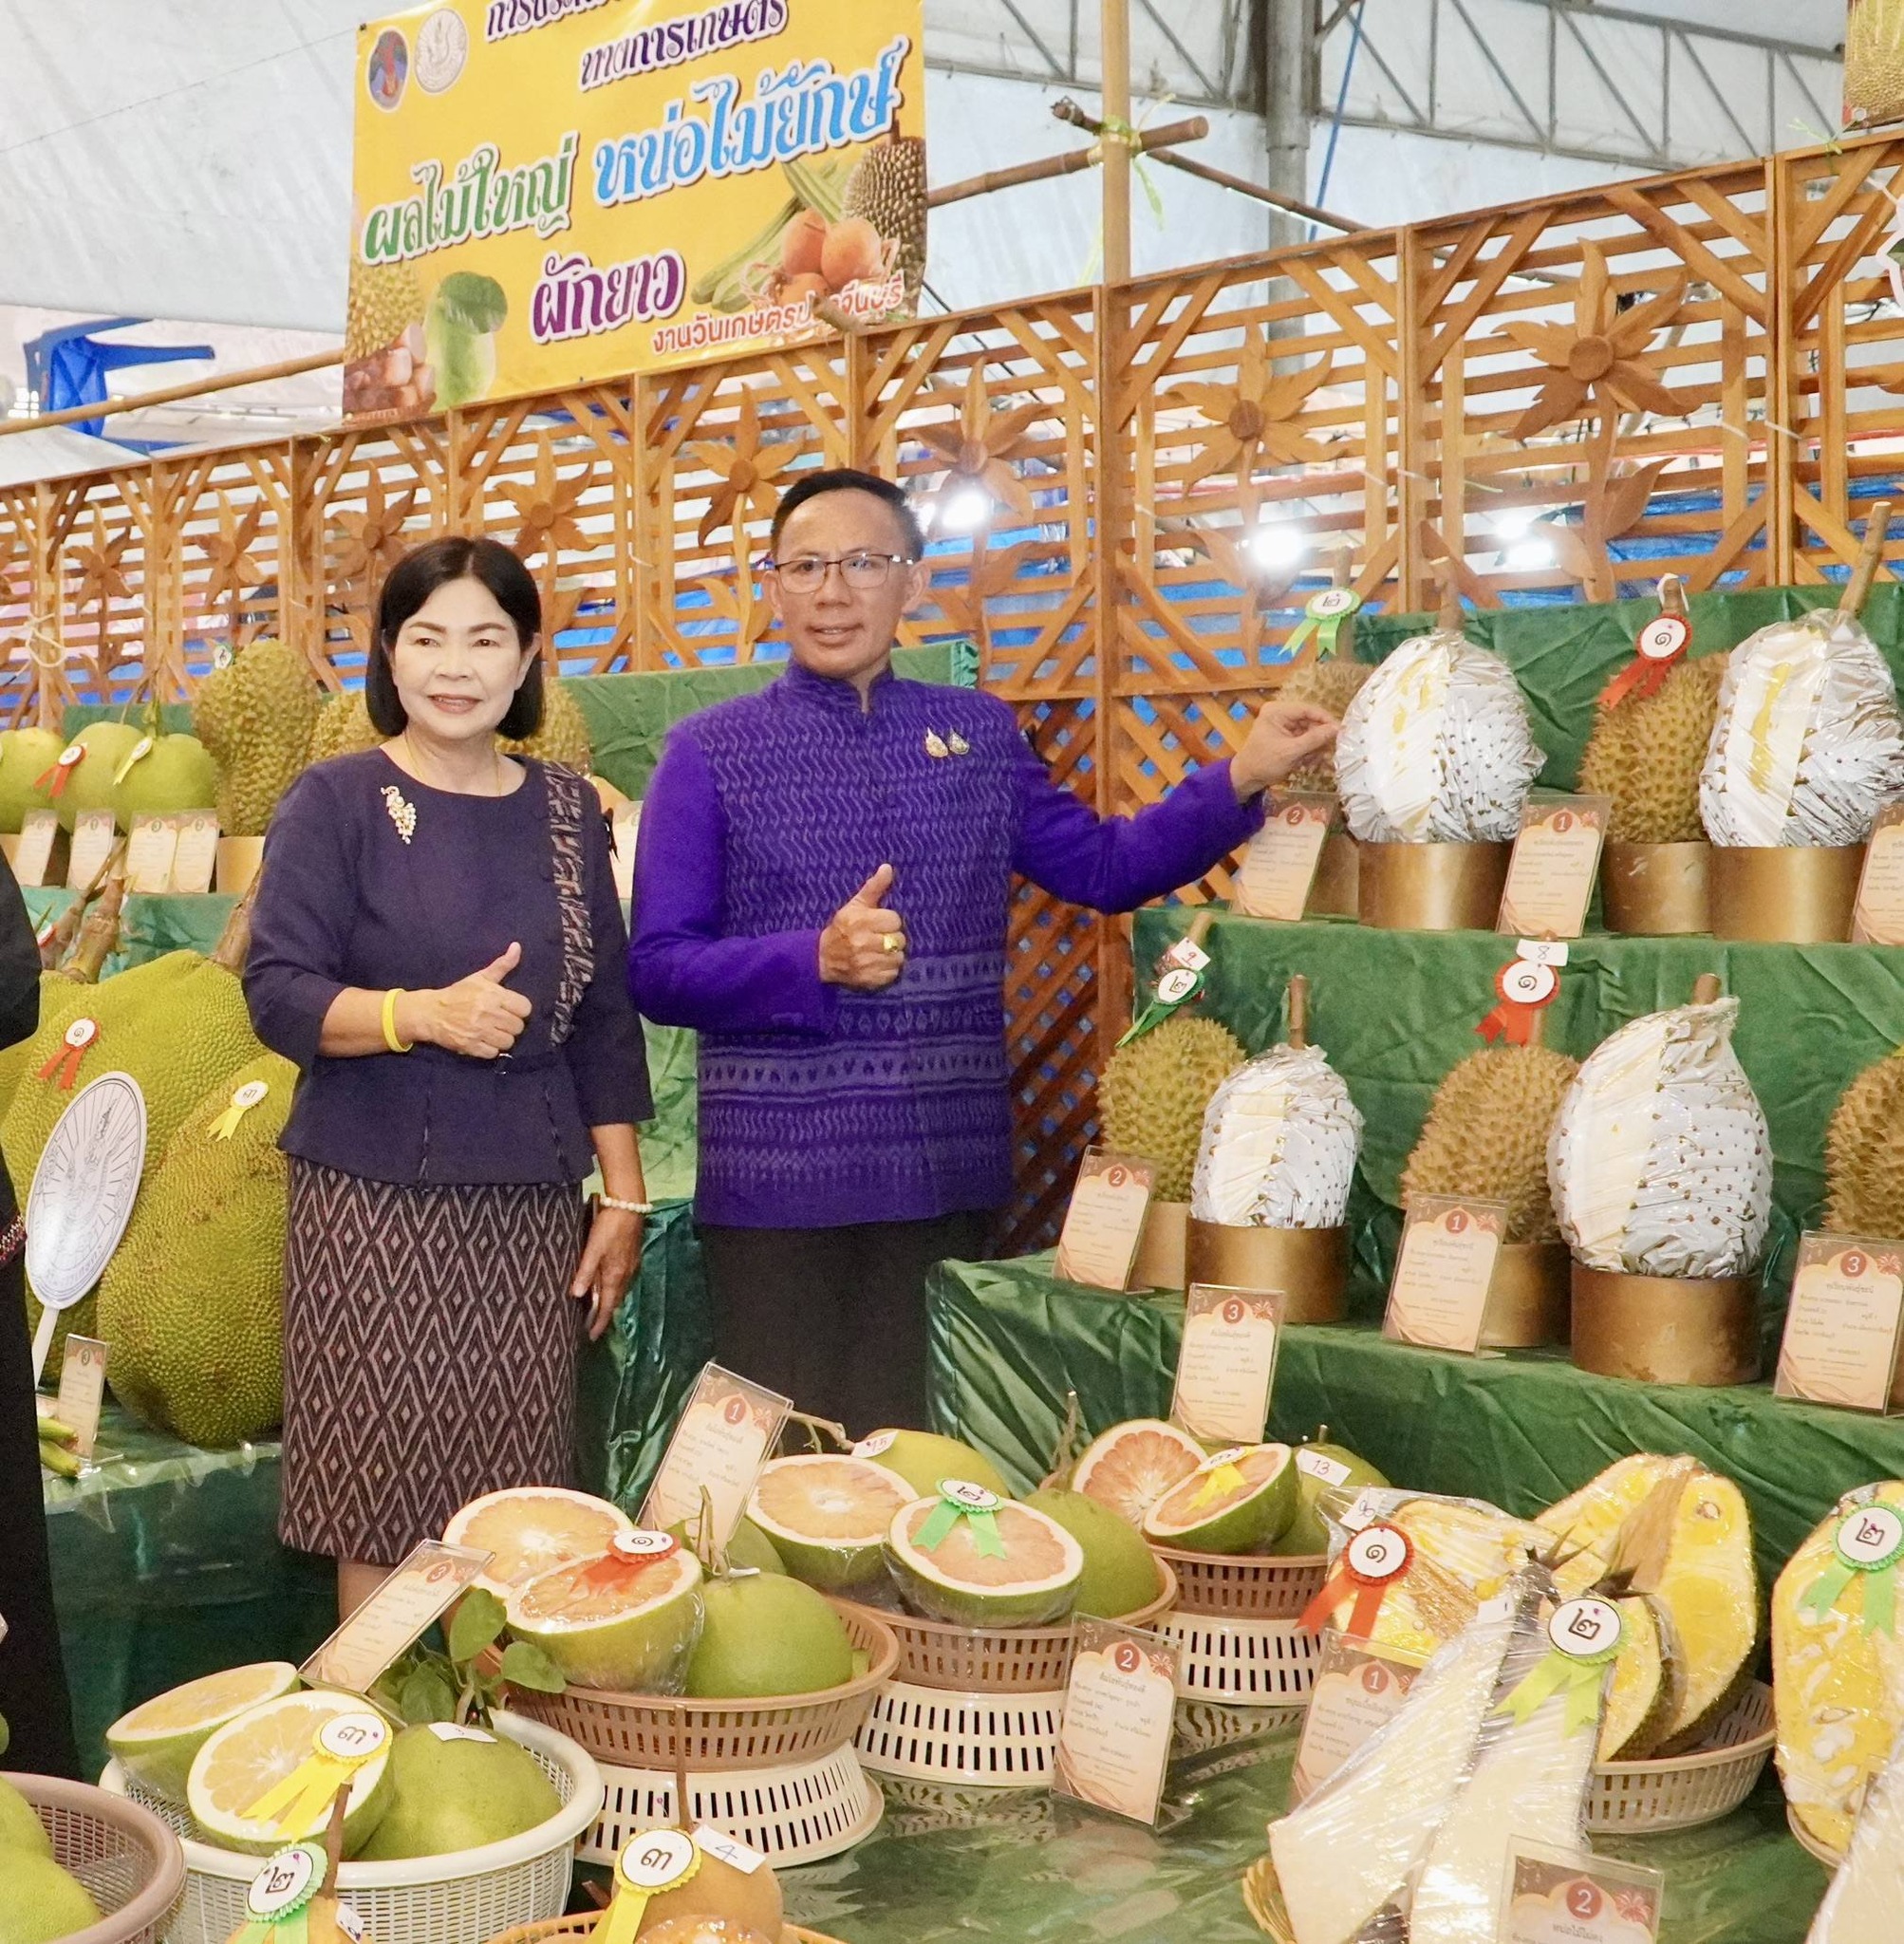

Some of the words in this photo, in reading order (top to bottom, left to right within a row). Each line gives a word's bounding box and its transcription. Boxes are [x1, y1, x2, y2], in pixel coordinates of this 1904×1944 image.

[582, 0, 785, 85] ทางการเกษตร
[364, 136, 574, 259] ผลไม้ใหญ่
[595, 40, 904, 201] หน่อไม้ยักษ์
[532, 254, 680, 338] ผักยาว
[1322, 594, 1341, 608] ๒
[1654, 632, 1672, 647] ๑
[1290, 810, 1300, 823] 2
[1558, 816, 1567, 831] 1
[1538, 945, 1550, 961] 8
[1168, 976, 1187, 994] ๒
[1518, 975, 1538, 991] ๑
[73, 1026, 85, 1038] ๑
[1111, 1169, 1123, 1185] 2
[1451, 1215, 1461, 1231] 1
[1846, 1256, 1860, 1273] 3
[1227, 1304, 1240, 1320] 3
[728, 1403, 741, 1421] 1
[1313, 1459, 1331, 1476] 13
[957, 1486, 981, 1502] ๒
[1855, 1517, 1886, 1547] ๒
[631, 1536, 654, 1547] ๑
[1365, 1543, 1388, 1564] ๑
[433, 1566, 447, 1580] 3
[1567, 1607, 1601, 1640] ๒
[1120, 1649, 1134, 1669] 2
[1368, 1671, 1379, 1691] 1
[337, 1726, 367, 1745] ๓
[641, 1848, 673, 1871] ๓
[715, 1844, 738, 1862] 4
[265, 1865, 295, 1895] ๒
[1575, 1888, 1593, 1915] 2
